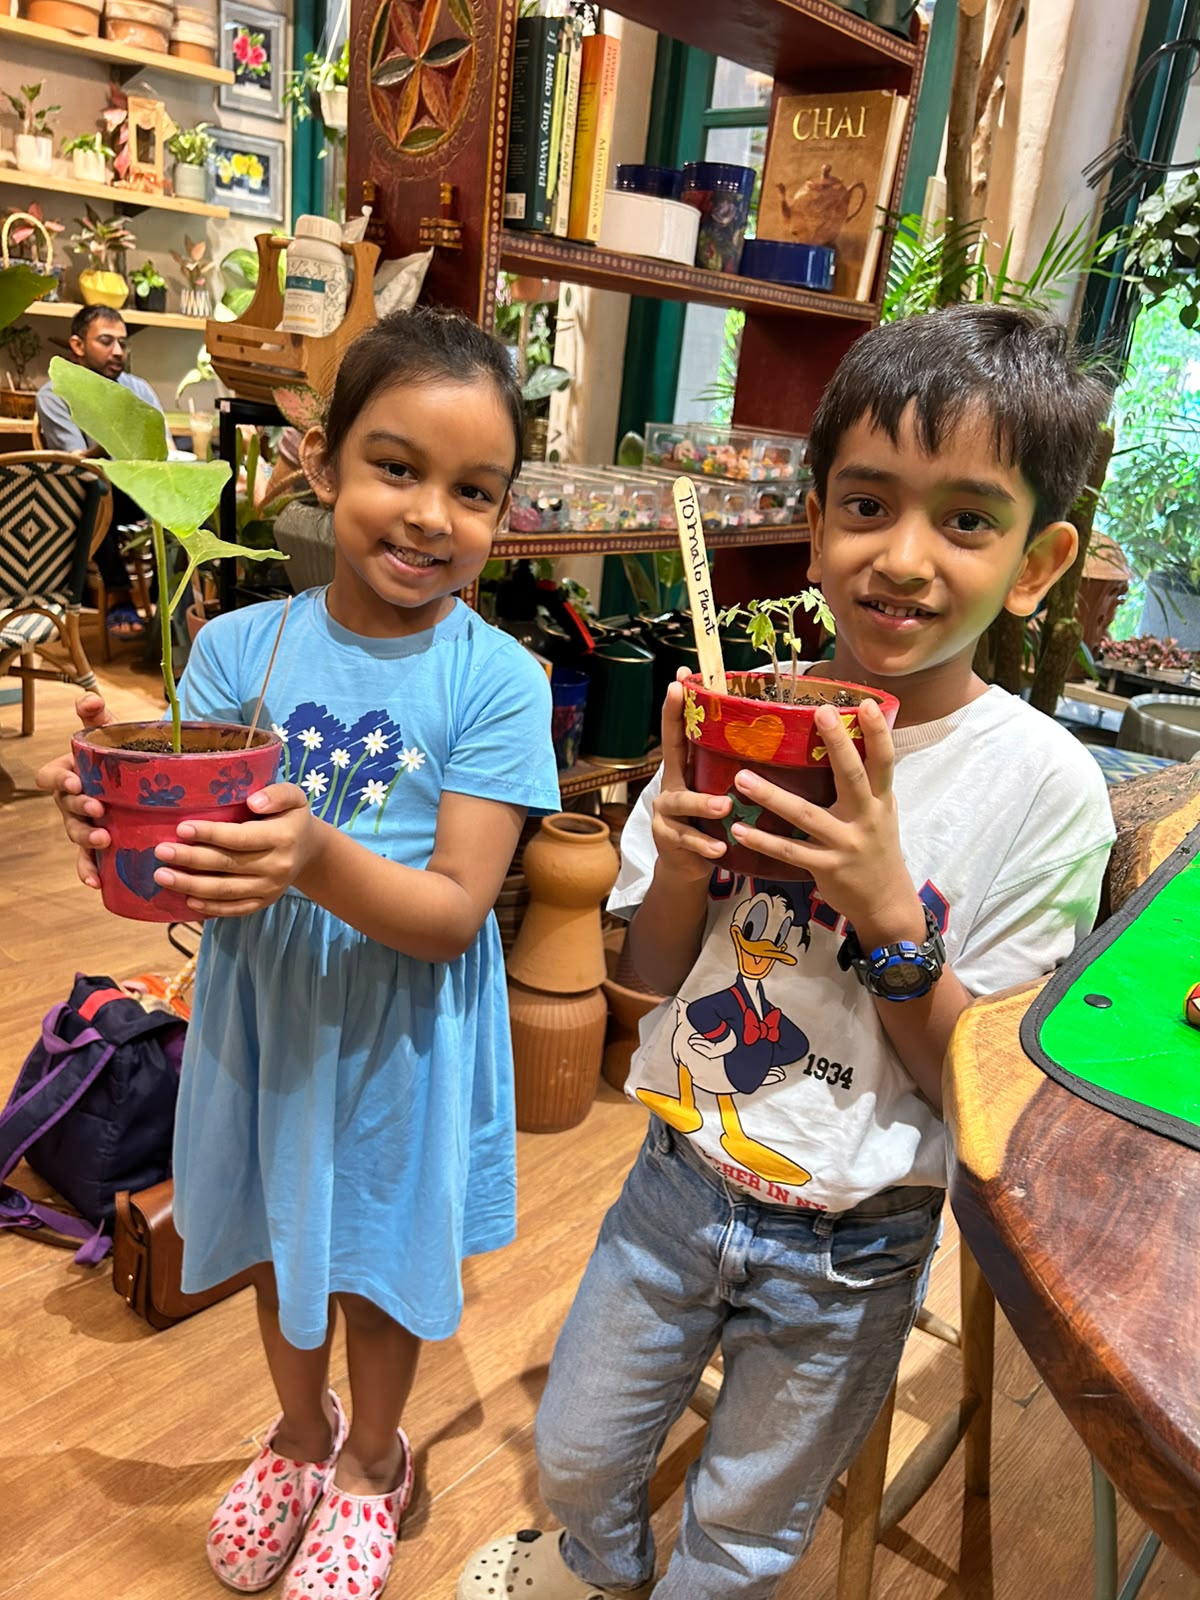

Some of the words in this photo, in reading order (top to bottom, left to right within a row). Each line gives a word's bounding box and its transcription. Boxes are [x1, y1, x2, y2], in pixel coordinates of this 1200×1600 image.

[544, 53, 555, 97] Hello
[540, 101, 552, 135] Tiny
[792, 106, 866, 141] CHAI
[538, 138, 549, 187] World
[561, 135, 572, 180] PLANT
[802, 1053, 853, 1090] 1934
[766, 1180, 790, 1204] IN
